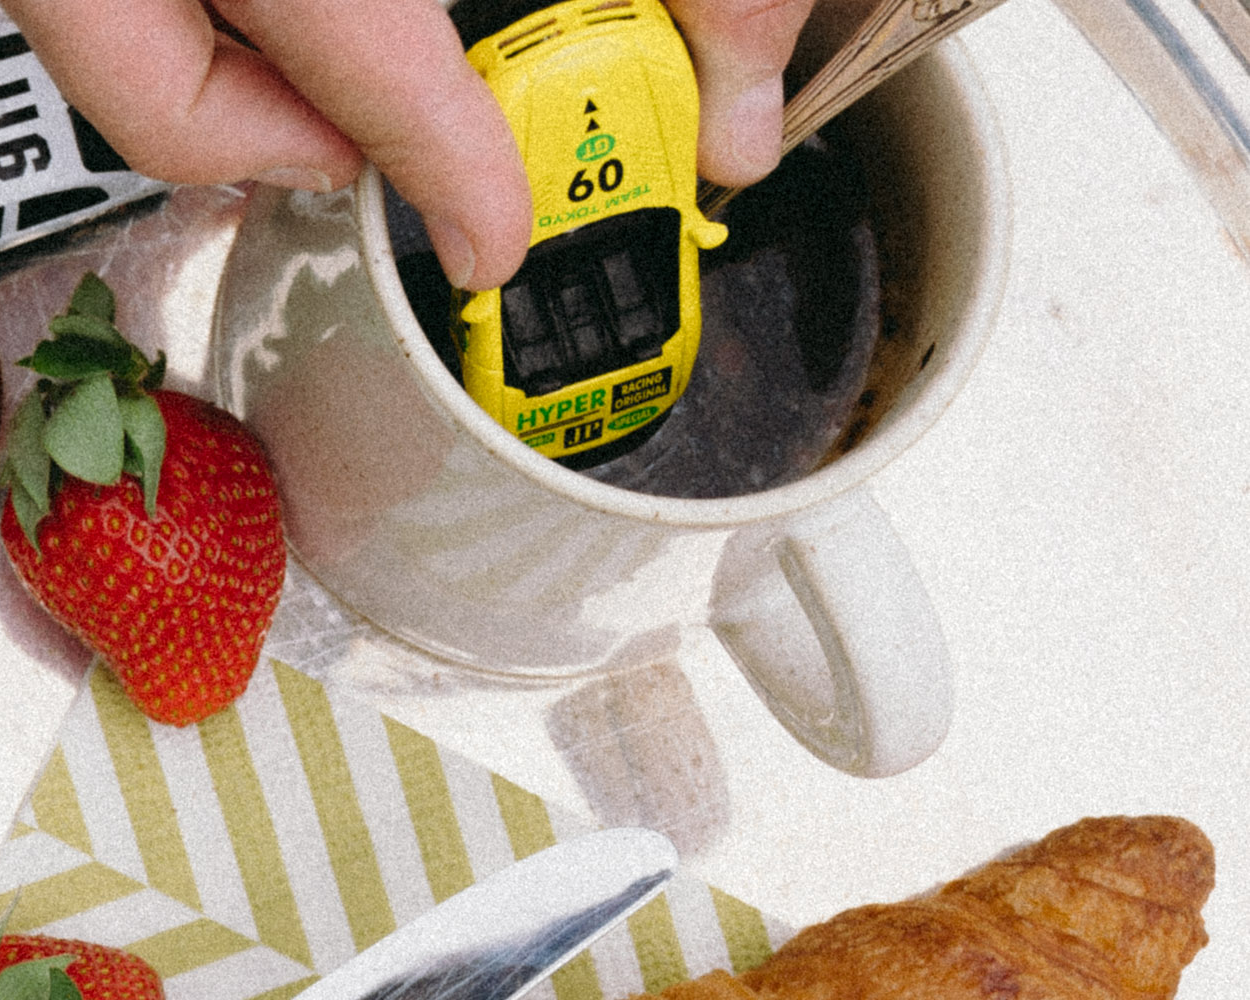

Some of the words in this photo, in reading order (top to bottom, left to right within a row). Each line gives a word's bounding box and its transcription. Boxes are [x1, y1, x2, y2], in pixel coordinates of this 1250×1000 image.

[605, 183, 651, 208] TEAM
[539, 204, 599, 228] TOKYO
[620, 373, 664, 396] RACING
[516, 389, 607, 431] HYPER
[614, 386, 668, 411] ORIGINAL
[611, 409, 654, 430] SPECIAL
